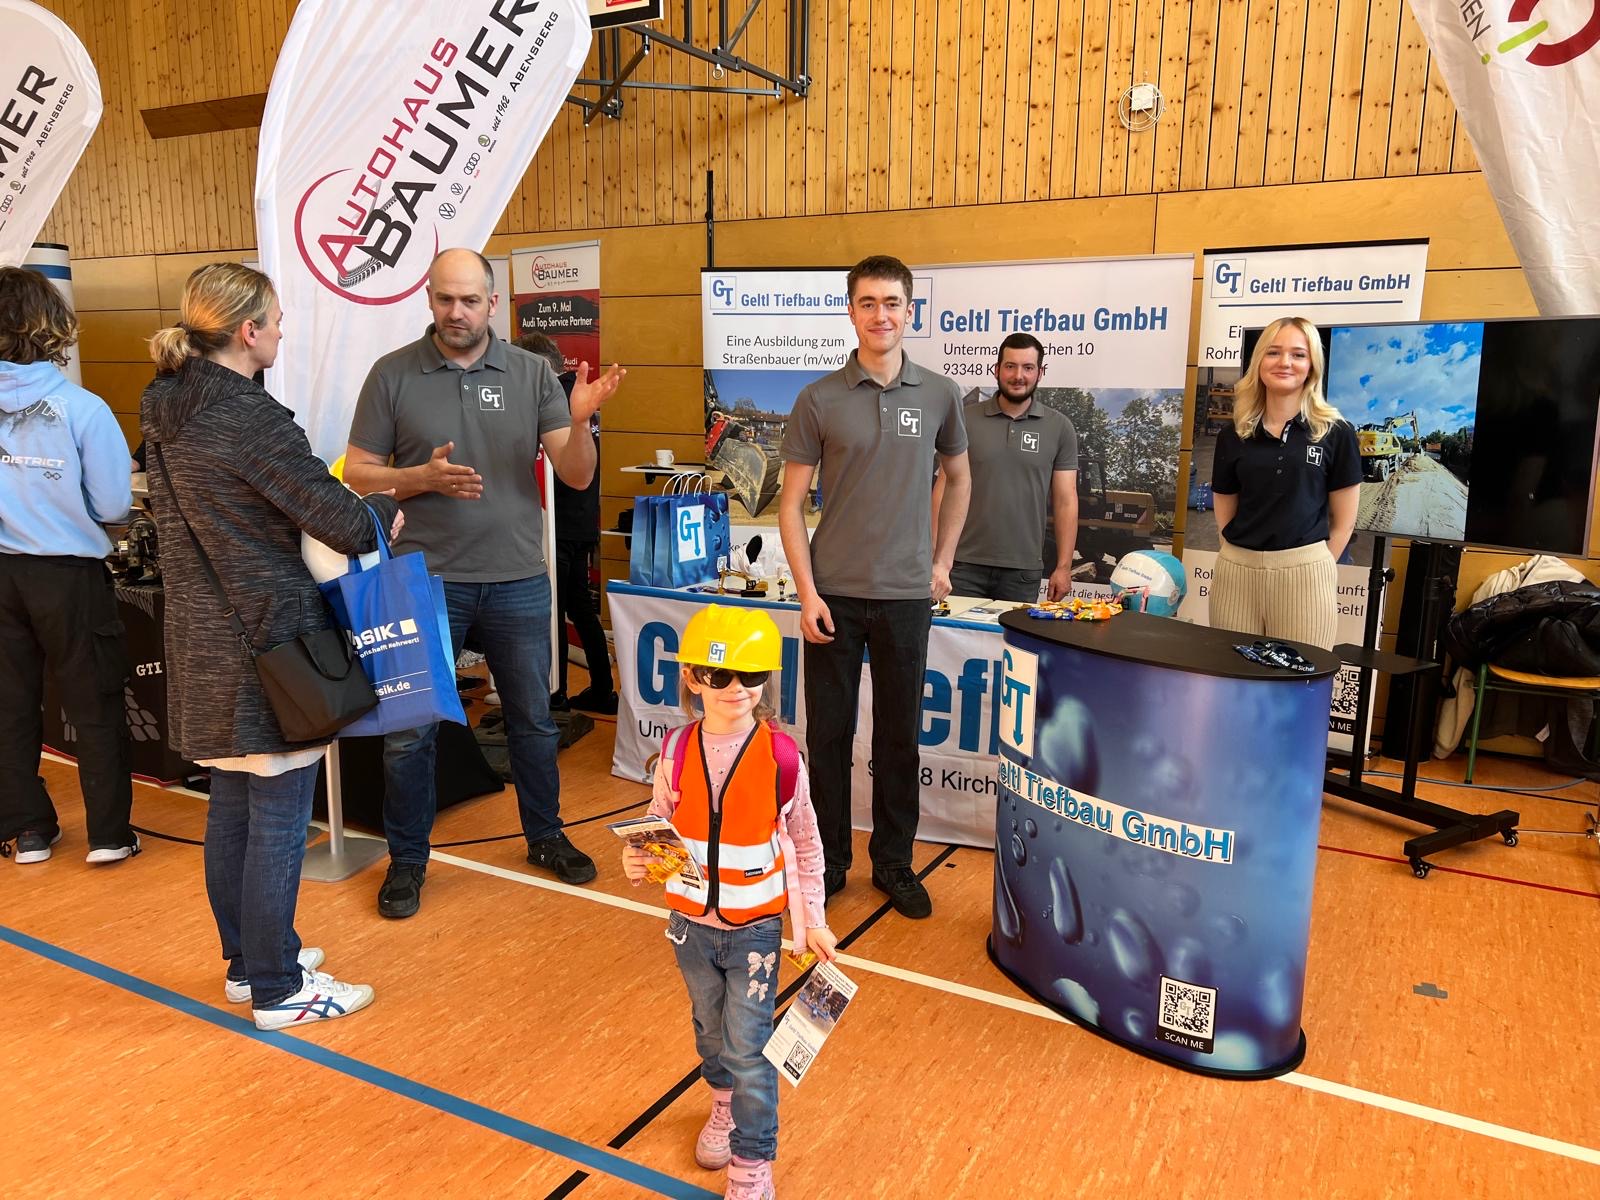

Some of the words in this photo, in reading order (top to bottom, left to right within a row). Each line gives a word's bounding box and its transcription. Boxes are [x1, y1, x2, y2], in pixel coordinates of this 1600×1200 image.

[497, 95, 510, 117] 1962
[509, 11, 559, 92] ABENSBERG
[36, 83, 75, 147] ABENSBERG
[355, 0, 540, 268] BAUMER
[318, 37, 459, 279] AUTOHAUS
[538, 267, 579, 281] BAUMER
[1215, 263, 1241, 294] GT
[1250, 277, 1286, 293] Geltl
[1291, 275, 1353, 292] Tiefbau
[1358, 274, 1411, 291] GmbH
[712, 279, 734, 306] GT
[741, 293, 770, 307] Geltl
[773, 293, 820, 307] Tiefbau
[824, 293, 850, 307] Gmb
[538, 303, 552, 313] Zum
[553, 302, 559, 312] 9.
[560, 301, 572, 312] Mal
[522, 317, 536, 328] Audi
[536, 317, 548, 330] Top
[548, 316, 569, 327] Service
[569, 315, 593, 326] Partner
[940, 308, 990, 332] Geltl
[998, 308, 1085, 332] Tiefbau
[1094, 306, 1168, 330] GmbH
[726, 335, 751, 347] Eine
[754, 335, 819, 349] Ausbildung
[820, 338, 845, 347] zum
[1077, 343, 1094, 355] 10
[722, 353, 800, 365] Straßenbauer
[1206, 347, 1242, 360] Rohr
[943, 363, 983, 375] 93348
[481, 388, 501, 408] GT
[900, 410, 919, 434] GT
[1023, 434, 1037, 449] GT
[1, 455, 65, 467] DISTRICT
[1308, 447, 1323, 465] GT
[679, 510, 701, 556] GT
[1077, 589, 1092, 599] die
[1337, 584, 1366, 597] unft
[711, 644, 724, 661] GT
[136, 661, 163, 677] GTI
[1001, 649, 1031, 746] GT
[1337, 721, 1352, 731] ME
[941, 768, 997, 796] Kirch
[1000, 761, 1022, 794] eltl
[1024, 770, 1113, 833] Tiefbau
[1121, 810, 1233, 862] GmbH
[1164, 1032, 1188, 1046] SCAN
[1190, 1040, 1204, 1050] ME
